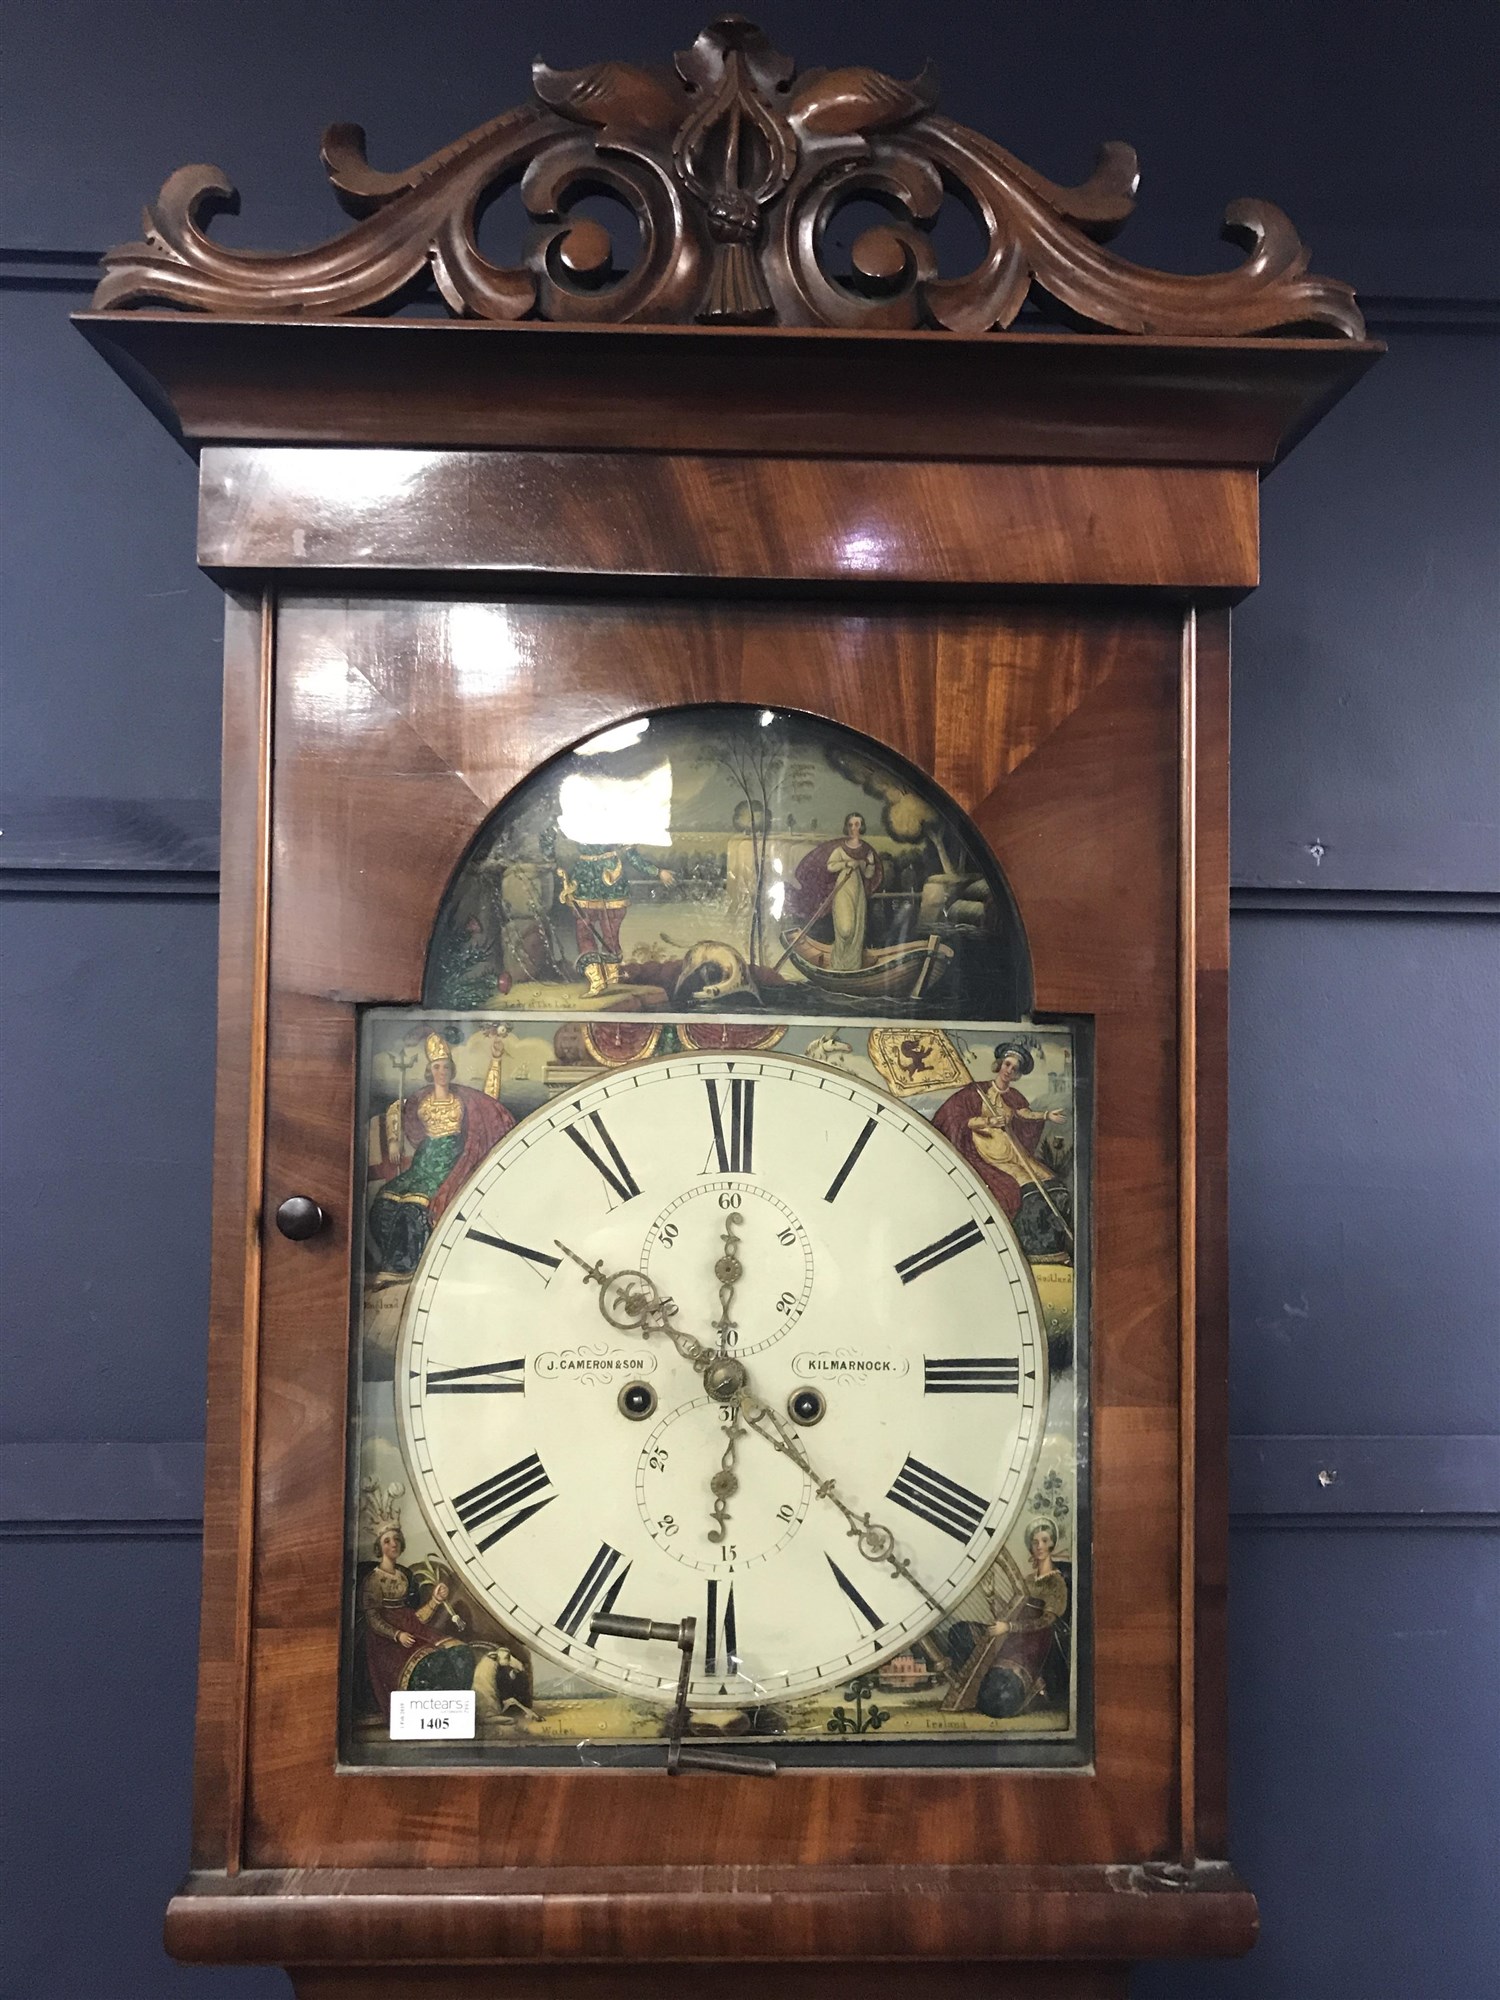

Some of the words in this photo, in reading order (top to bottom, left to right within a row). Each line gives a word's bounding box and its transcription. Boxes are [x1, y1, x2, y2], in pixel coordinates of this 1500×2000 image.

[697, 1079, 760, 1175] XII
[559, 1108, 645, 1214] XI
[821, 1115, 879, 1203] I
[718, 1192, 742, 1210] 60
[465, 1210, 565, 1289] X
[658, 1223, 679, 1249] 50
[776, 1226, 796, 1247] 10
[893, 1216, 987, 1286] II
[775, 1291, 797, 1316] 20
[426, 1355, 526, 1398] IX
[808, 1360, 896, 1371] KILMARNOCK.
[923, 1354, 1019, 1398] III
[718, 1405, 736, 1422] 31
[649, 1445, 669, 1473] 25
[450, 1448, 560, 1557] VIII
[884, 1450, 990, 1546] IIII
[657, 1514, 680, 1537] 20
[776, 1504, 795, 1524] 10
[721, 1545, 737, 1562] 15
[824, 1550, 889, 1640] V
[704, 1579, 738, 1677] VI
[410, 1698, 463, 1710] mctears
[420, 1718, 450, 1730] 1405
